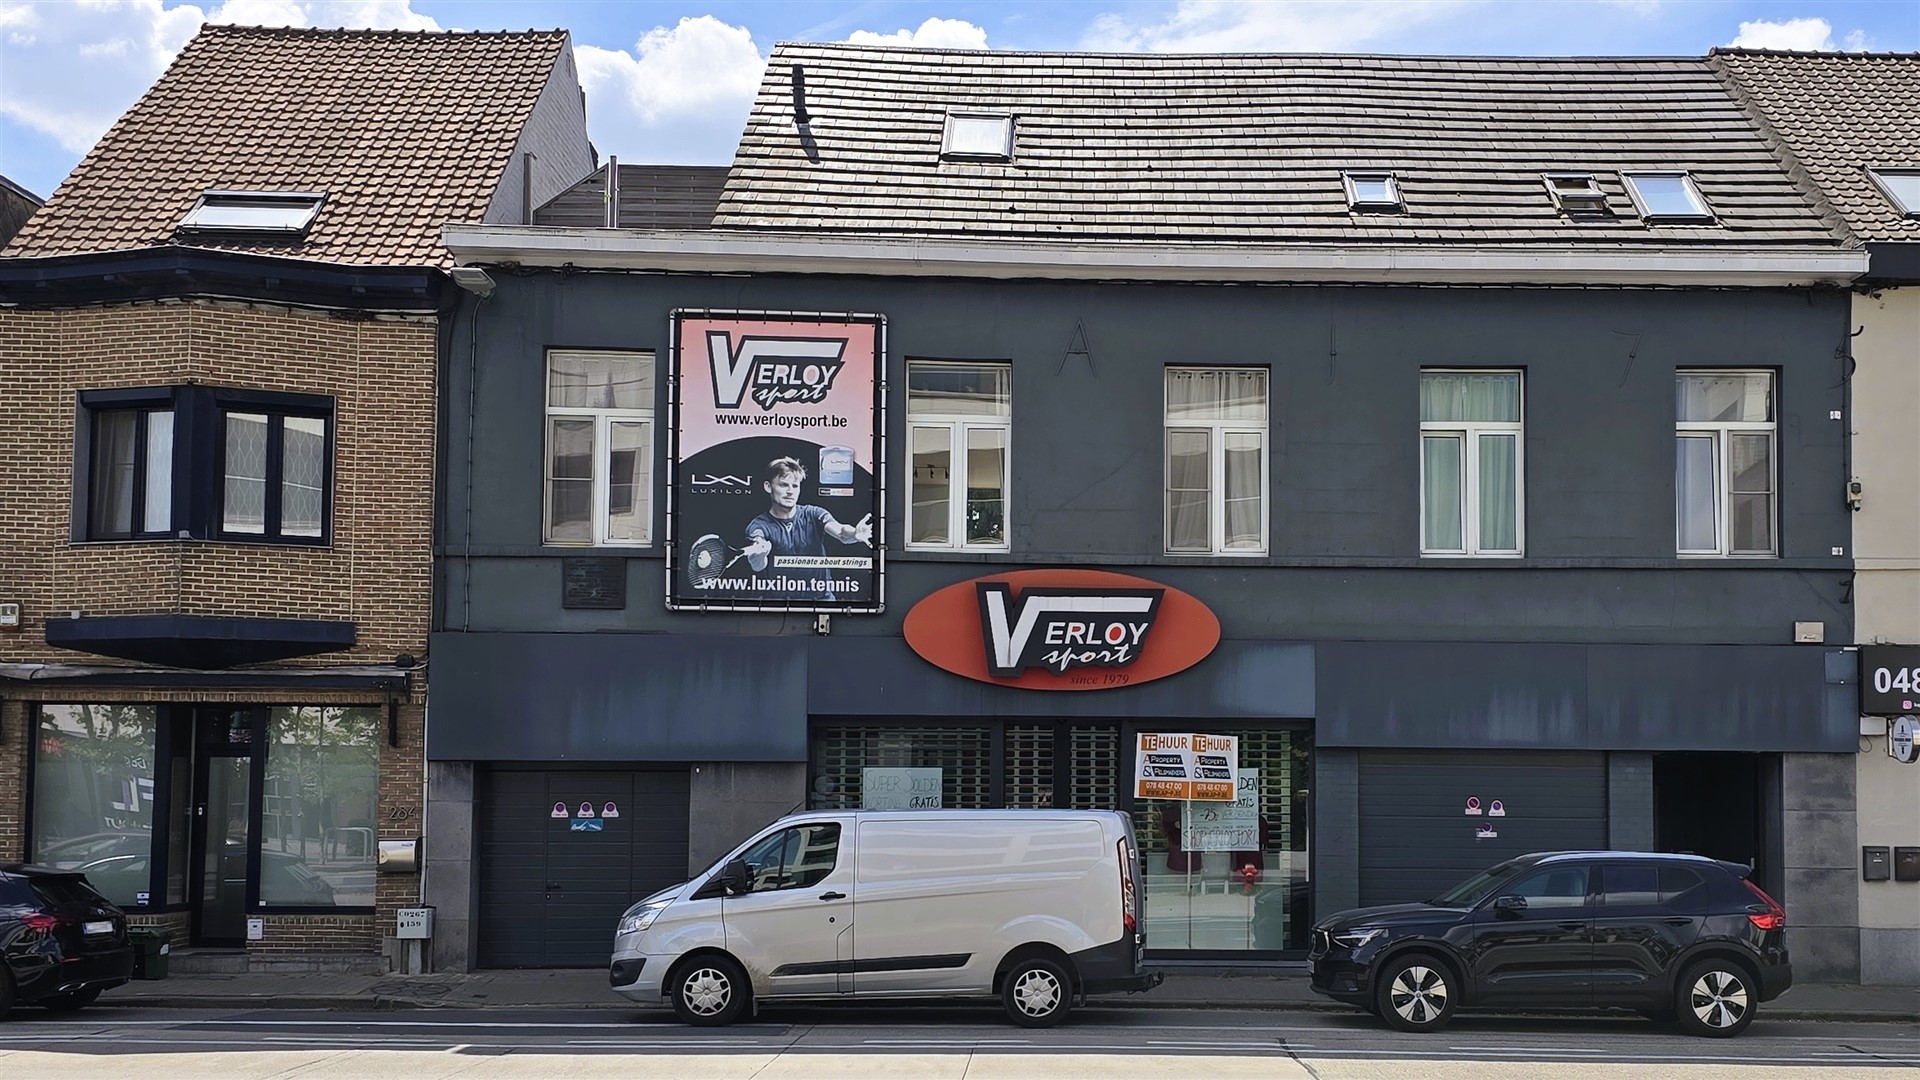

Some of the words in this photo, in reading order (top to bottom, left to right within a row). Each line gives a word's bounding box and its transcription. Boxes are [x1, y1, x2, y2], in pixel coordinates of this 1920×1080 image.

[710, 335, 843, 404] VERLOY
[756, 385, 824, 407] sport
[715, 413, 848, 429] www.verloysport.be
[777, 558, 818, 567] passionate
[820, 558, 841, 566] about
[842, 558, 867, 568] strings
[701, 575, 860, 592] www.luxilon.tennis
[985, 591, 1153, 668] VERLOY
[1041, 644, 1132, 671] sport
[1070, 675, 1098, 685] since
[1103, 674, 1129, 685] 1979
[1159, 736, 1188, 749] HUUR
[1207, 737, 1232, 752] HUUR
[865, 770, 901, 792] SUPER
[1174, 783, 1183, 791] 00
[909, 796, 940, 808] GRATIS
